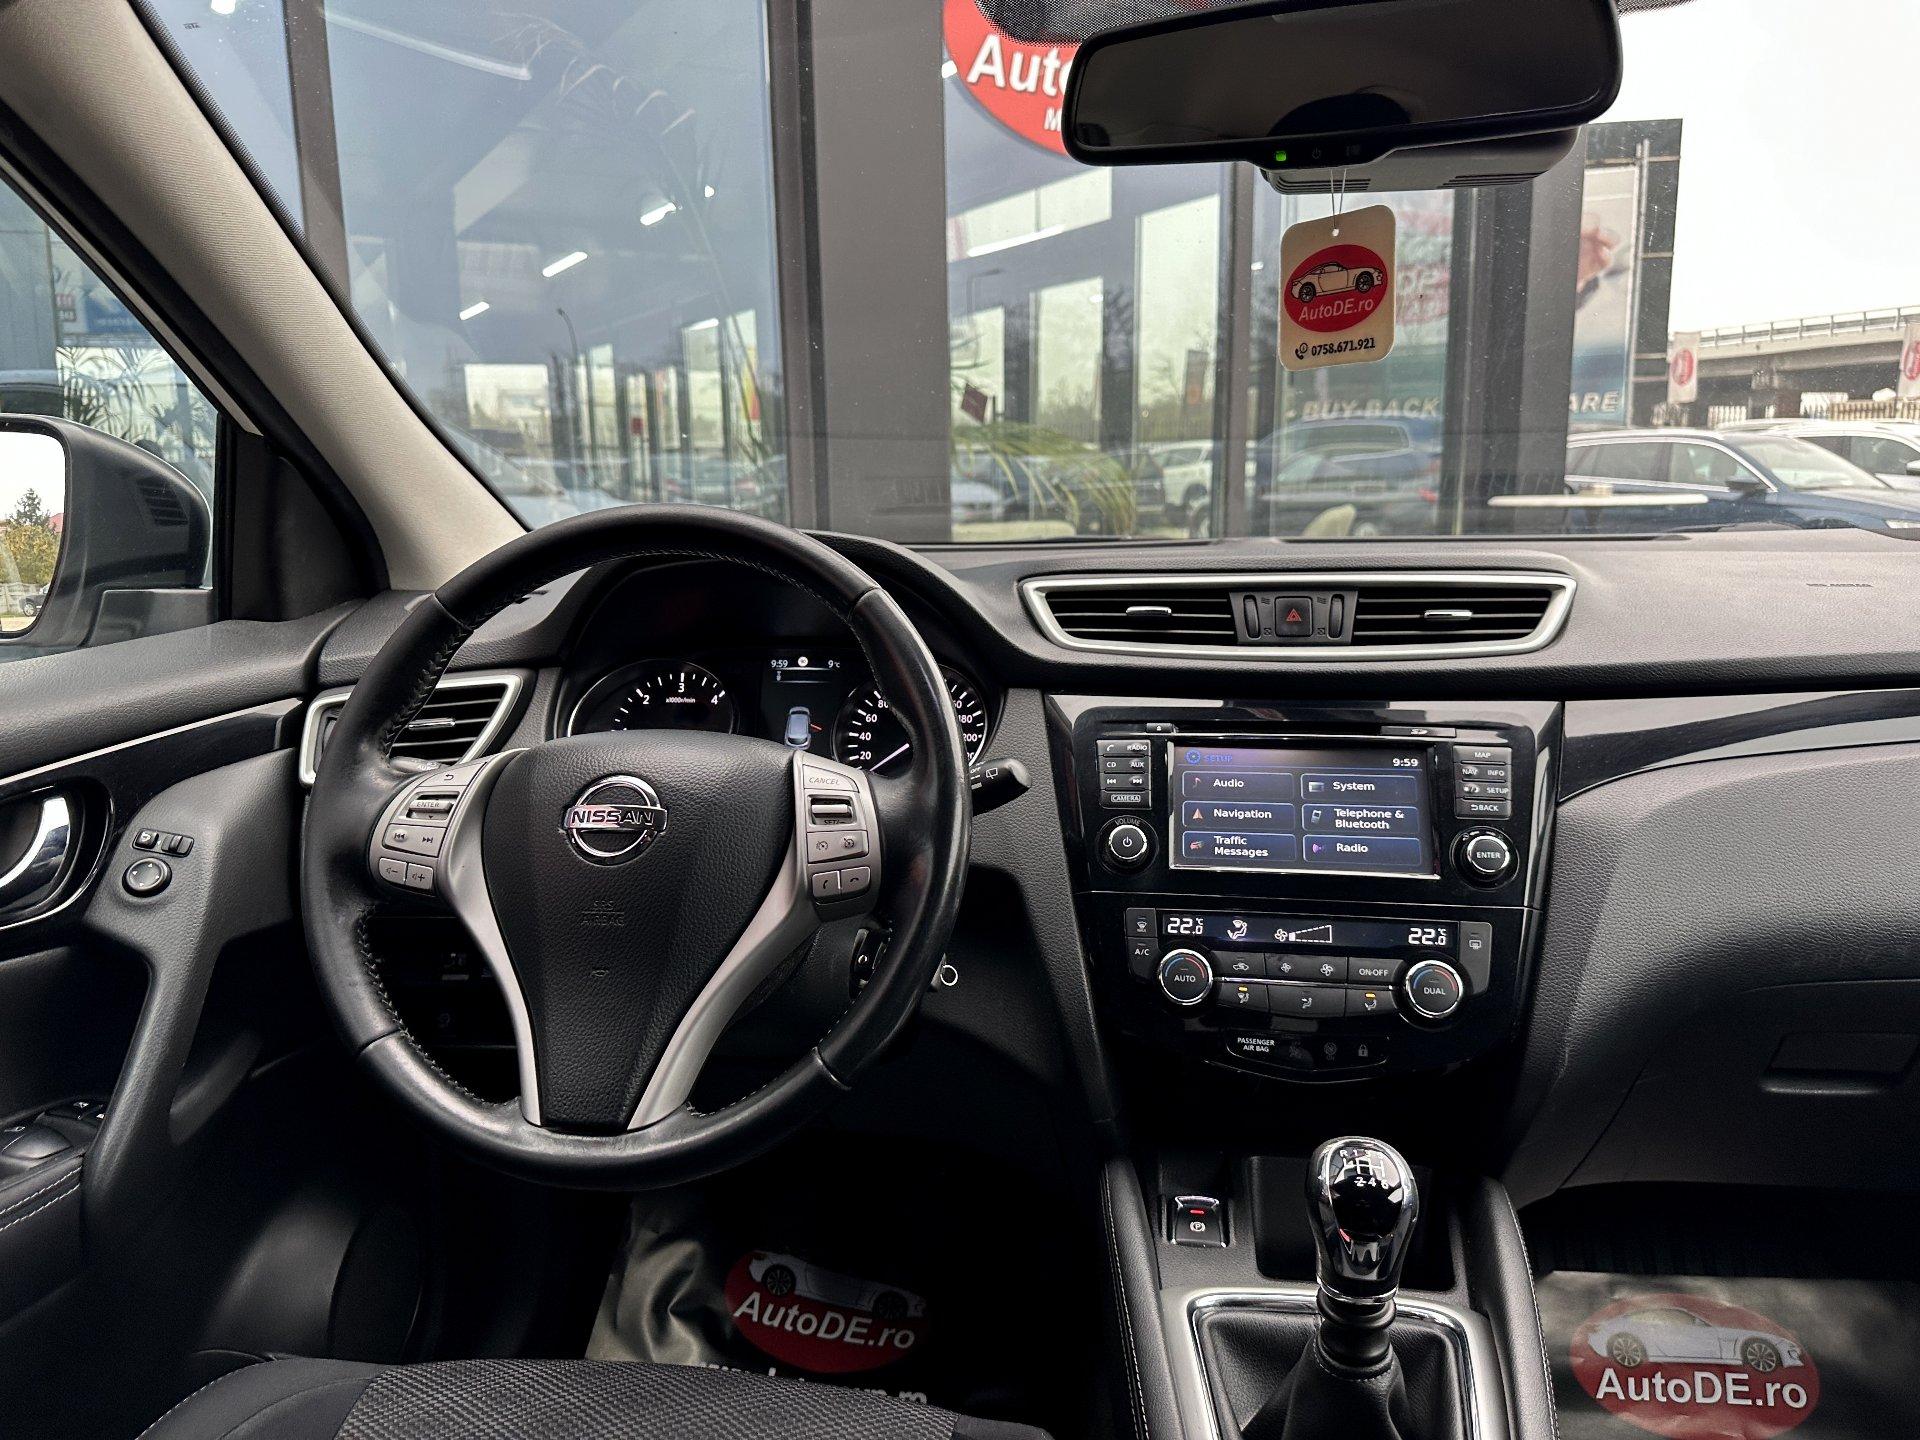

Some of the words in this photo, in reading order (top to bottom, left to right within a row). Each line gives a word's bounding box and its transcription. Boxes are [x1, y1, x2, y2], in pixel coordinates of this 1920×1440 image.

[1298, 298, 1374, 321] AutoDE.ro
[1311, 337, 1375, 356] 0758.671.921
[1364, 397, 1439, 418] BACK
[771, 659, 789, 668] 9:59
[678, 682, 685, 693] 3
[642, 694, 650, 705] 2
[710, 694, 719, 705] 4
[865, 713, 878, 723] 60
[858, 731, 872, 741] 40
[1126, 744, 1148, 752] RADIO
[859, 752, 872, 760] 20
[1204, 753, 1233, 763] SETUP
[1106, 761, 1117, 769] CD
[1130, 761, 1144, 769] AUX
[1392, 757, 1419, 767] 9:59
[1462, 768, 1478, 776] NAV
[1487, 769, 1505, 777] INFO
[808, 776, 840, 786] CANCEL
[1213, 778, 1245, 788] Audio
[1332, 781, 1376, 792] System
[1478, 804, 1499, 812] BACK
[571, 809, 655, 826] NISSAN
[1213, 808, 1272, 819] Navigation
[1333, 808, 1392, 819] Telephone
[1394, 810, 1405, 819] &
[1114, 818, 1141, 827] VOLUME
[1335, 819, 1390, 829] Bluetooth
[1213, 835, 1248, 845] Traffic
[1214, 846, 1269, 858] Messages
[1336, 842, 1368, 853] Radio
[1476, 851, 1501, 859] ENTER
[1134, 948, 1150, 956] A/C
[1173, 974, 1196, 983] AUTO
[1423, 987, 1446, 995] DUAL
[1237, 1037, 1275, 1046] PASSENGER
[1367, 1177, 1377, 1188] 4
[733, 1291, 915, 1349] AutoDE.ro
[1596, 1367, 1807, 1409] AutoDE.ro
